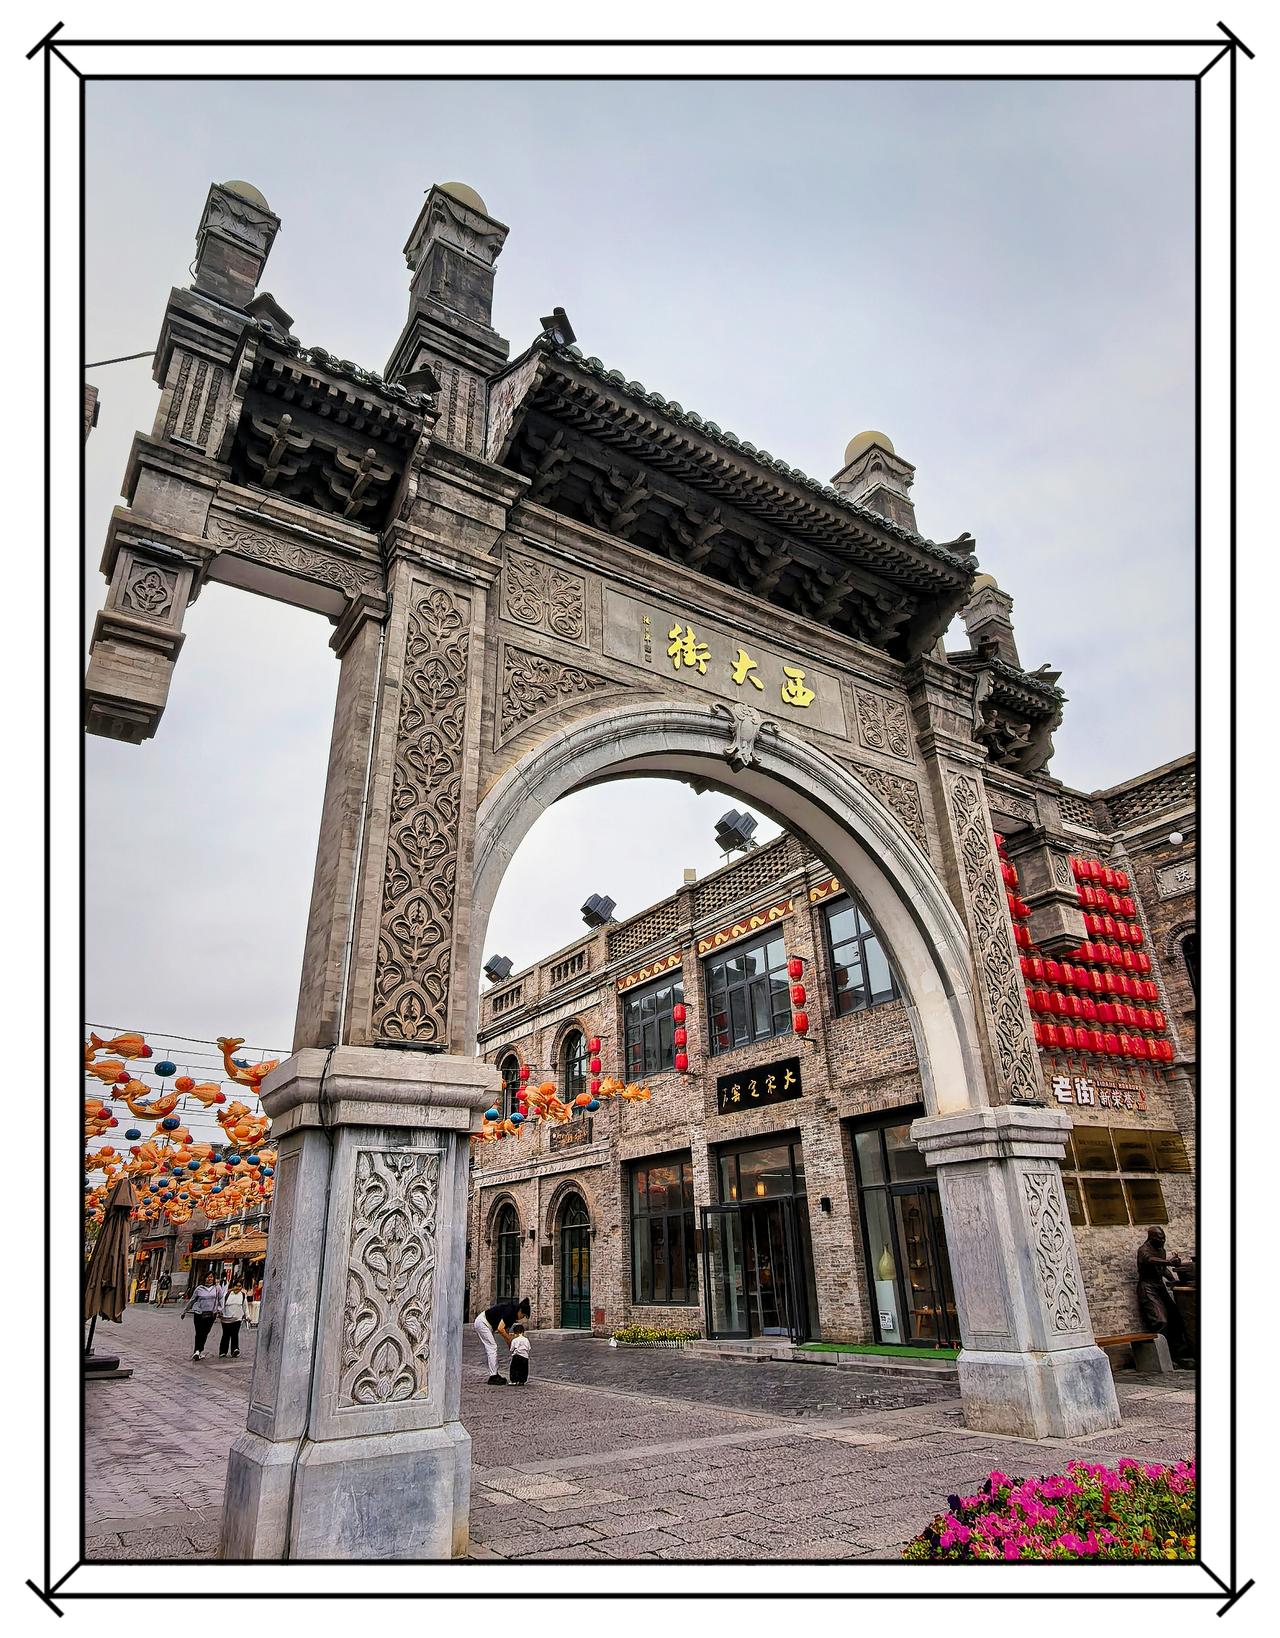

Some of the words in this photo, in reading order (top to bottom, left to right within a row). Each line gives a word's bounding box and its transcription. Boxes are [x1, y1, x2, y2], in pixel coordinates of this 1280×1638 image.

[667, 623, 816, 708] 西大街
[1052, 1075, 1095, 1105] 老街
